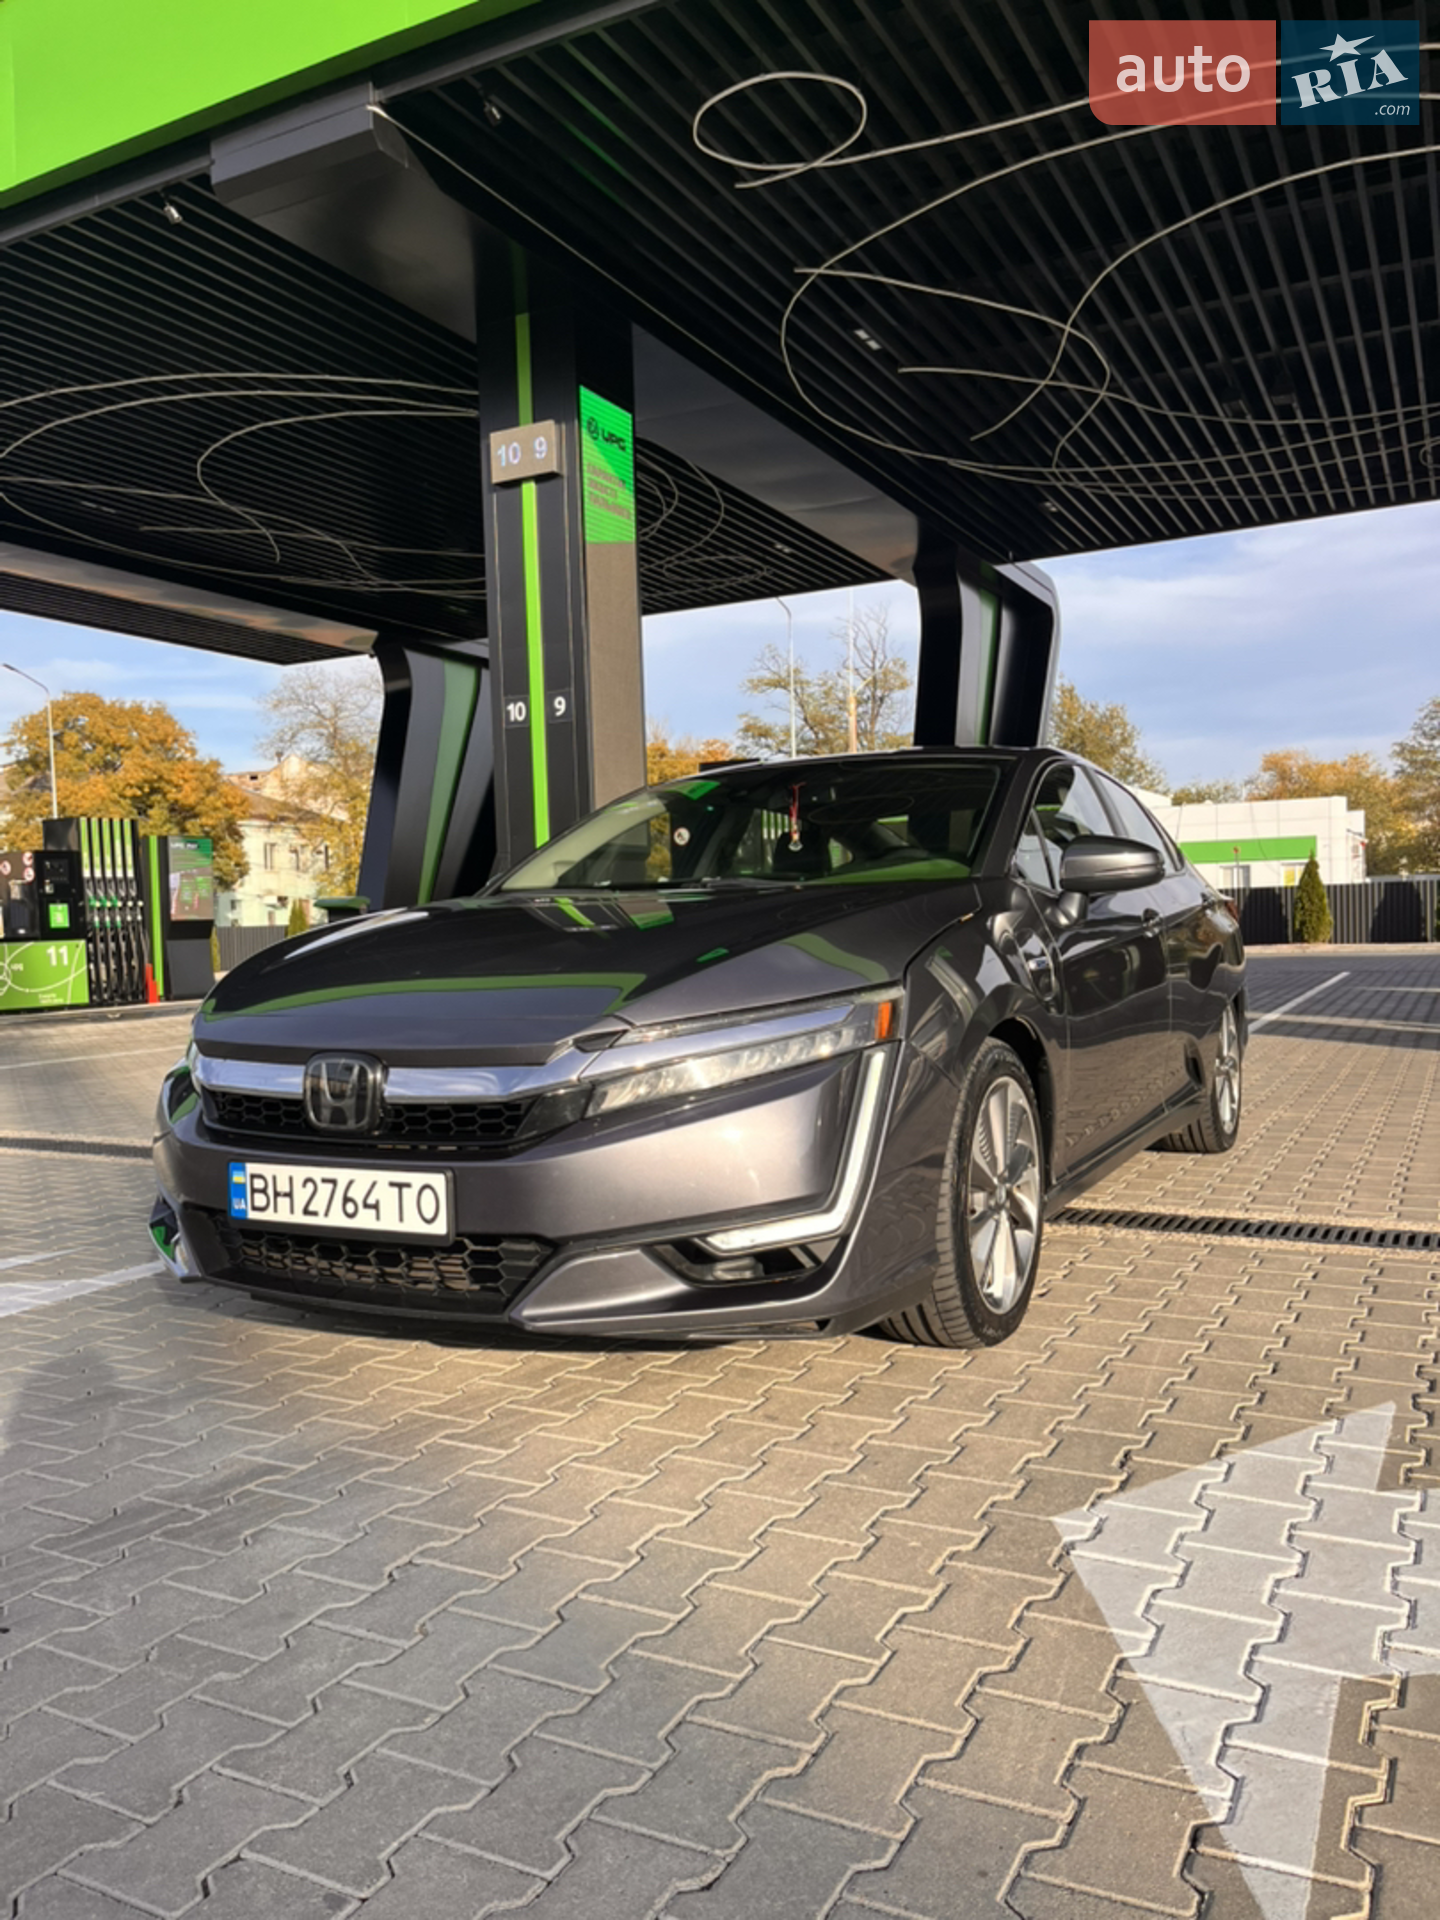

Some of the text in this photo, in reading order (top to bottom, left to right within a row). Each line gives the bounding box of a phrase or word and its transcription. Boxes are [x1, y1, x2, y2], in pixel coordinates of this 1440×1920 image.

[497, 436, 548, 467] 10 9
[506, 696, 567, 722] 10 9
[46, 945, 69, 967] 11
